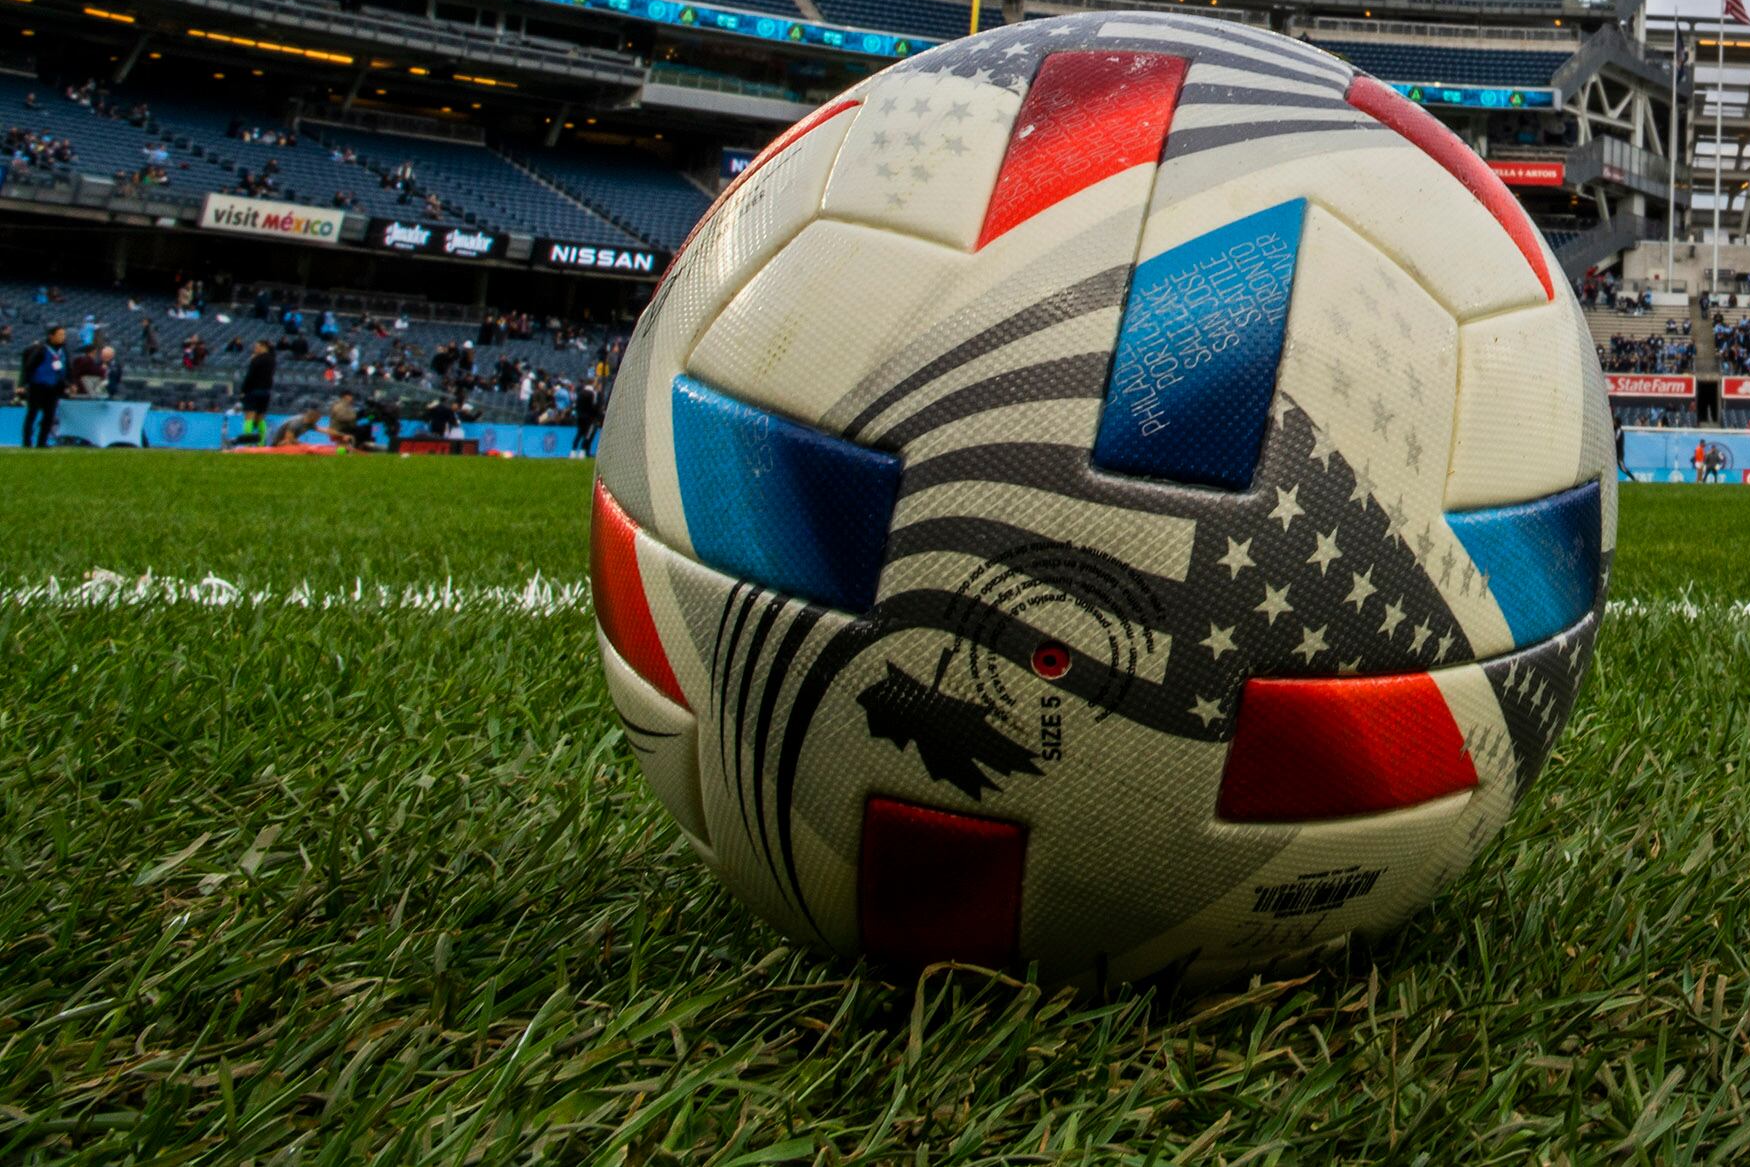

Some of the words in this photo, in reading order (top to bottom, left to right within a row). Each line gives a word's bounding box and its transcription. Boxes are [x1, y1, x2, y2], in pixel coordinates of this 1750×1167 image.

[213, 205, 259, 229] visit
[550, 244, 655, 271] NISSAN
[1140, 277, 1188, 326] LAKE
[1170, 263, 1217, 307] JOSE
[1199, 251, 1261, 328] SEATTLE
[1227, 240, 1284, 325] TORONTO
[1123, 297, 1184, 390] PORTLAN
[1197, 308, 1239, 353] SAN
[1024, 589, 1067, 608] presión
[1073, 592, 1113, 630] pression
[1042, 696, 1062, 708] 5
[1042, 714, 1062, 761] SIZE
